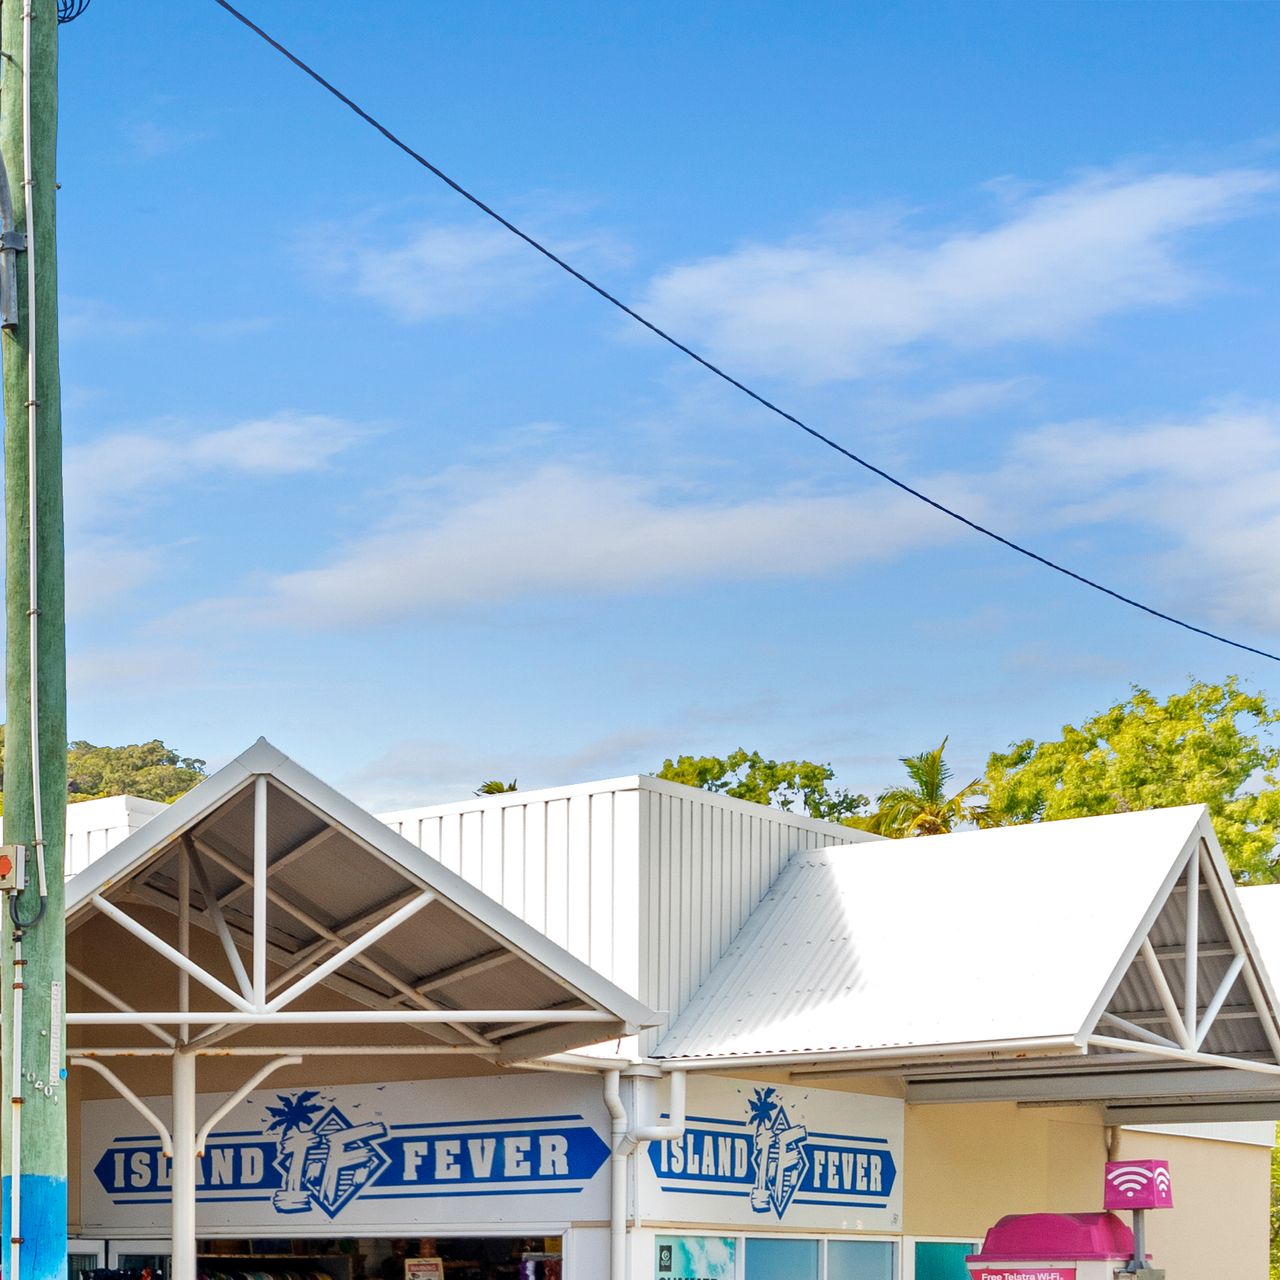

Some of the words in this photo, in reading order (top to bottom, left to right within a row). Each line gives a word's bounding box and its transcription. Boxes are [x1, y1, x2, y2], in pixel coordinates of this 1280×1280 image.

[402, 1134, 569, 1182] FEVER
[660, 1133, 748, 1179] ISLAND
[812, 1149, 883, 1192] FEVER
[981, 1273, 1003, 1280] Free
[1003, 1272, 1036, 1280] Telstra
